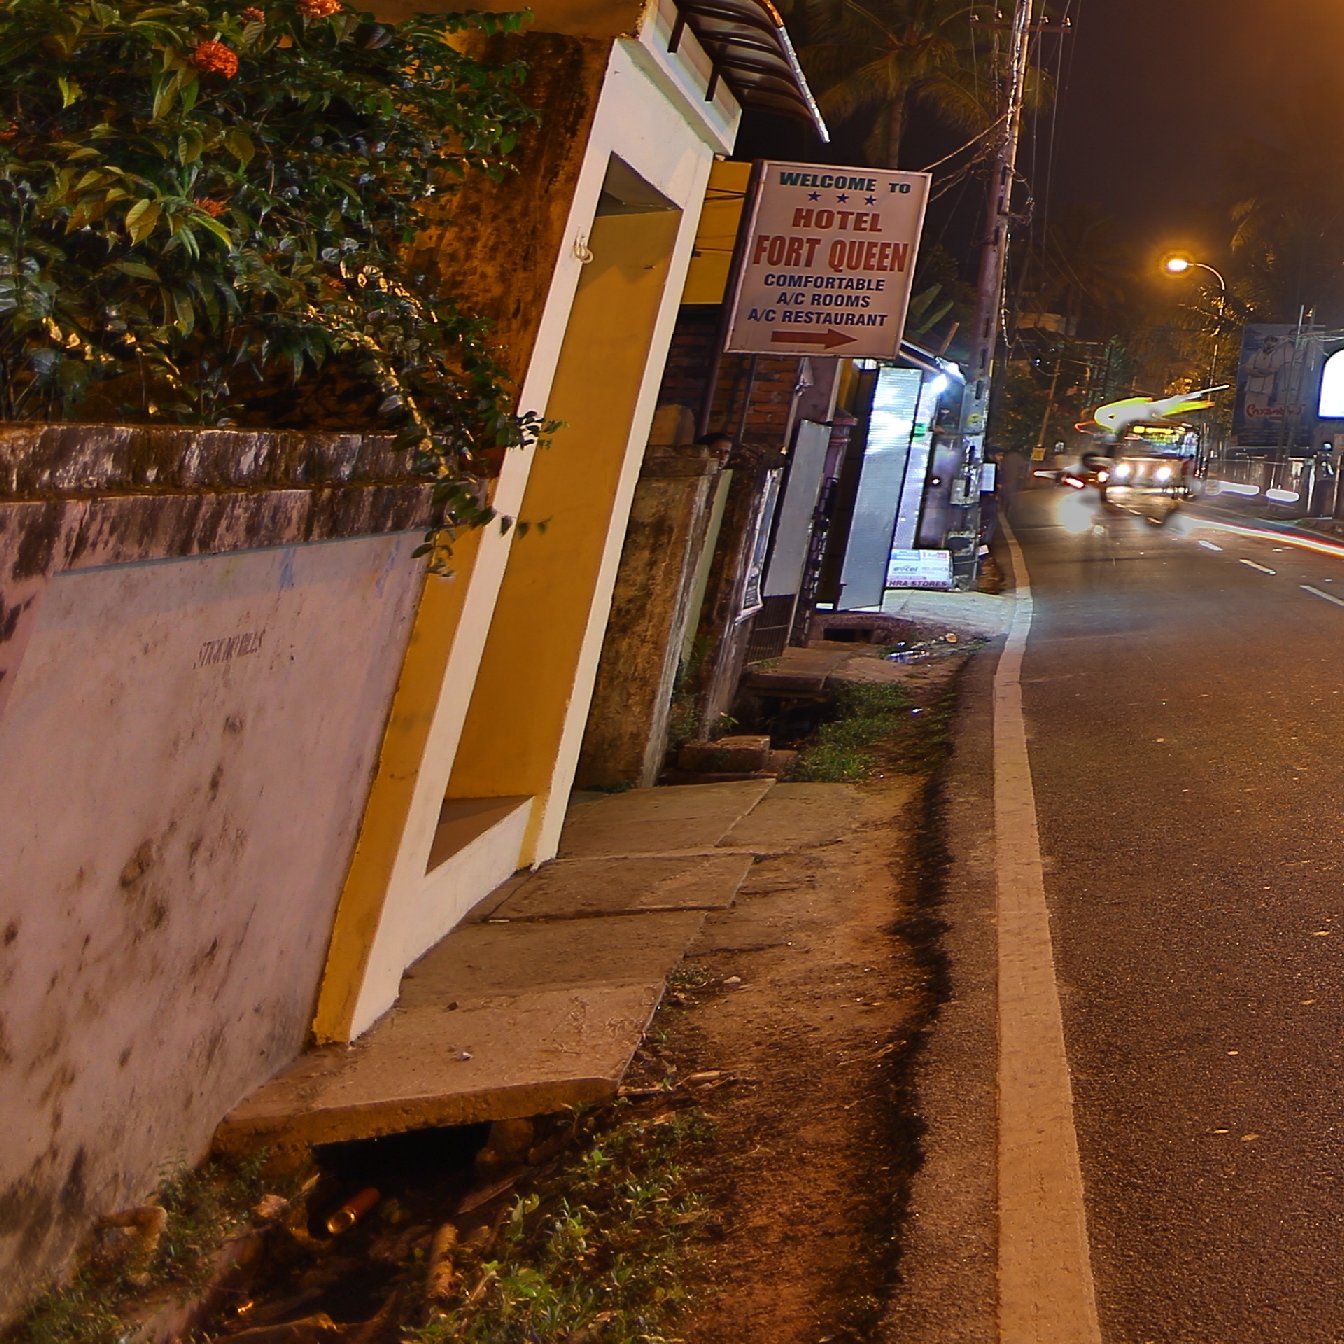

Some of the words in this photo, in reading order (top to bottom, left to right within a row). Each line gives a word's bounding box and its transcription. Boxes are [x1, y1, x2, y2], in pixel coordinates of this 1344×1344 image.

[779, 171, 877, 192] WELCOME
[889, 182, 911, 194] TO
[792, 207, 883, 232] HOTEL
[753, 235, 822, 268] FORT
[828, 239, 909, 273] QUEEN
[764, 273, 886, 291] COMFORTABLE
[776, 291, 805, 306] A/C
[811, 294, 870, 308] ROOMS
[747, 309, 777, 323] A/C
[782, 310, 888, 326] RESTAURANT
